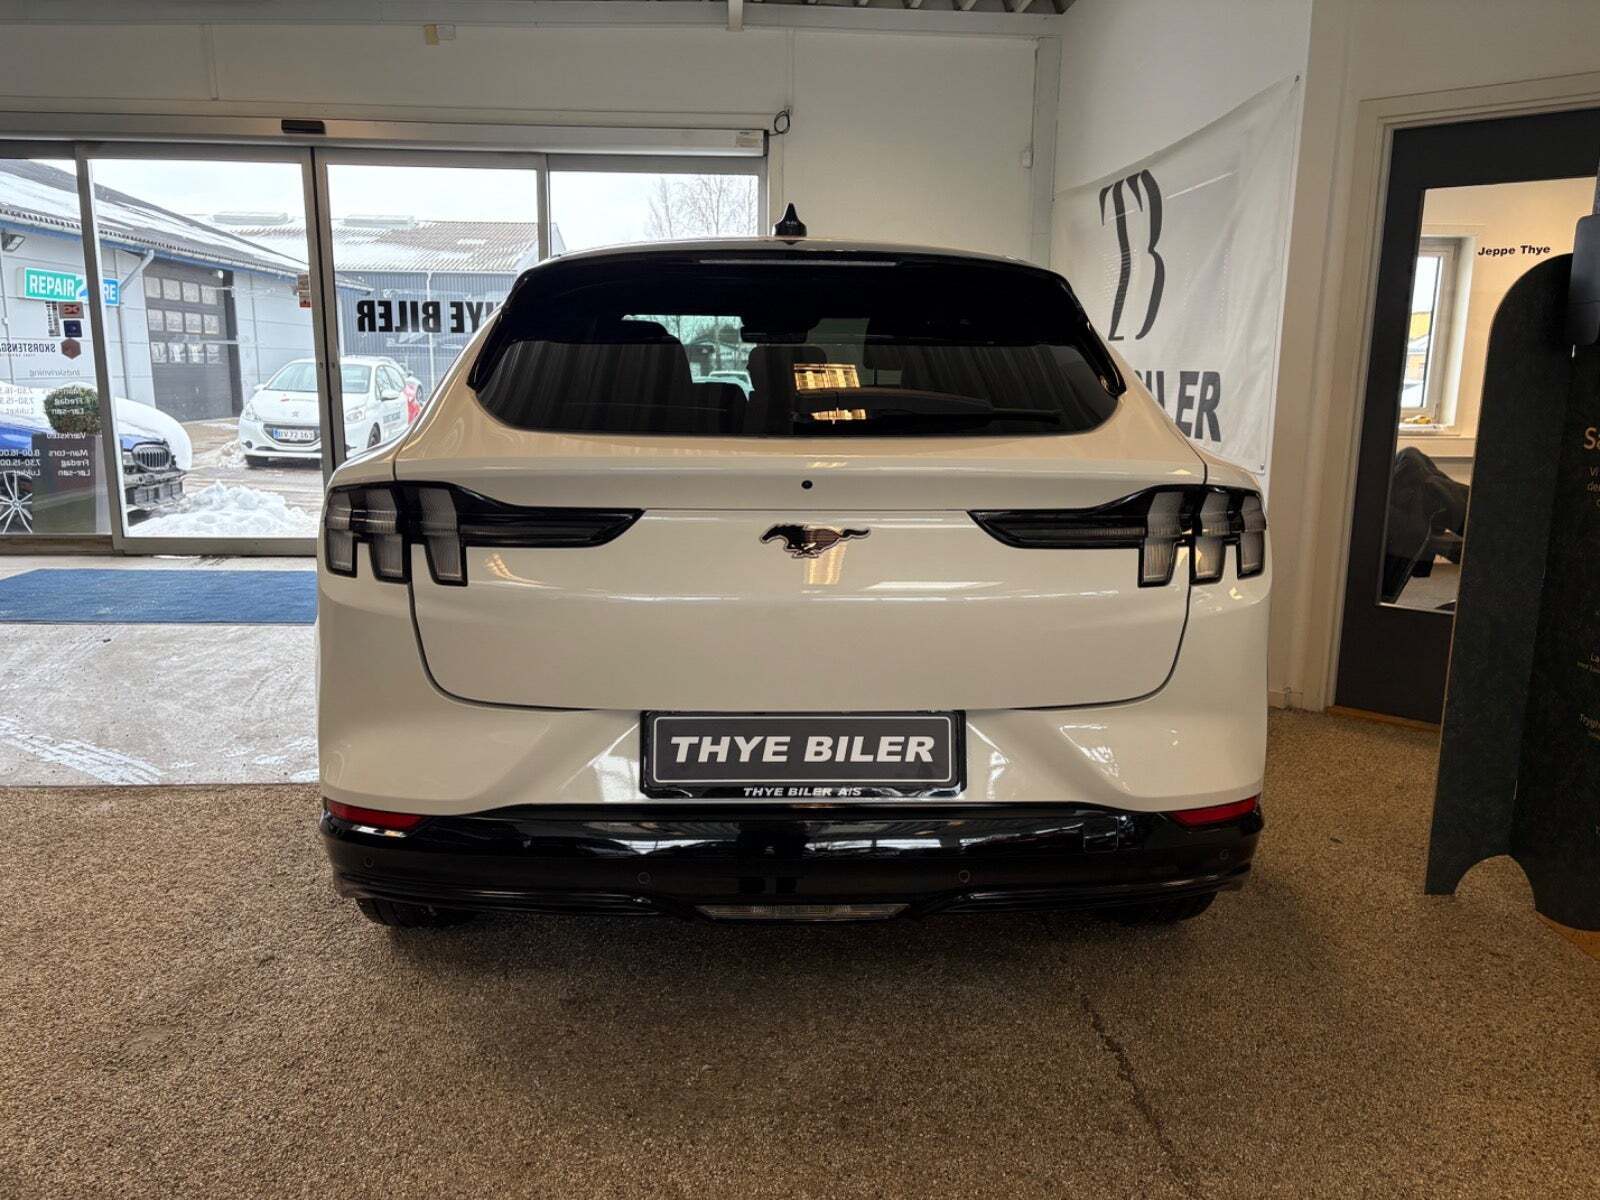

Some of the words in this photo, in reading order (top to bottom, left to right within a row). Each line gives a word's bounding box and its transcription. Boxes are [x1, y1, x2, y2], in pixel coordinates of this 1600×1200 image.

[1477, 247, 1516, 257] Jeppe
[1520, 244, 1551, 255] Thye
[671, 736, 791, 763] THYE
[804, 736, 935, 763] BILER
[743, 787, 784, 797] THYE
[788, 787, 833, 797] BILER
